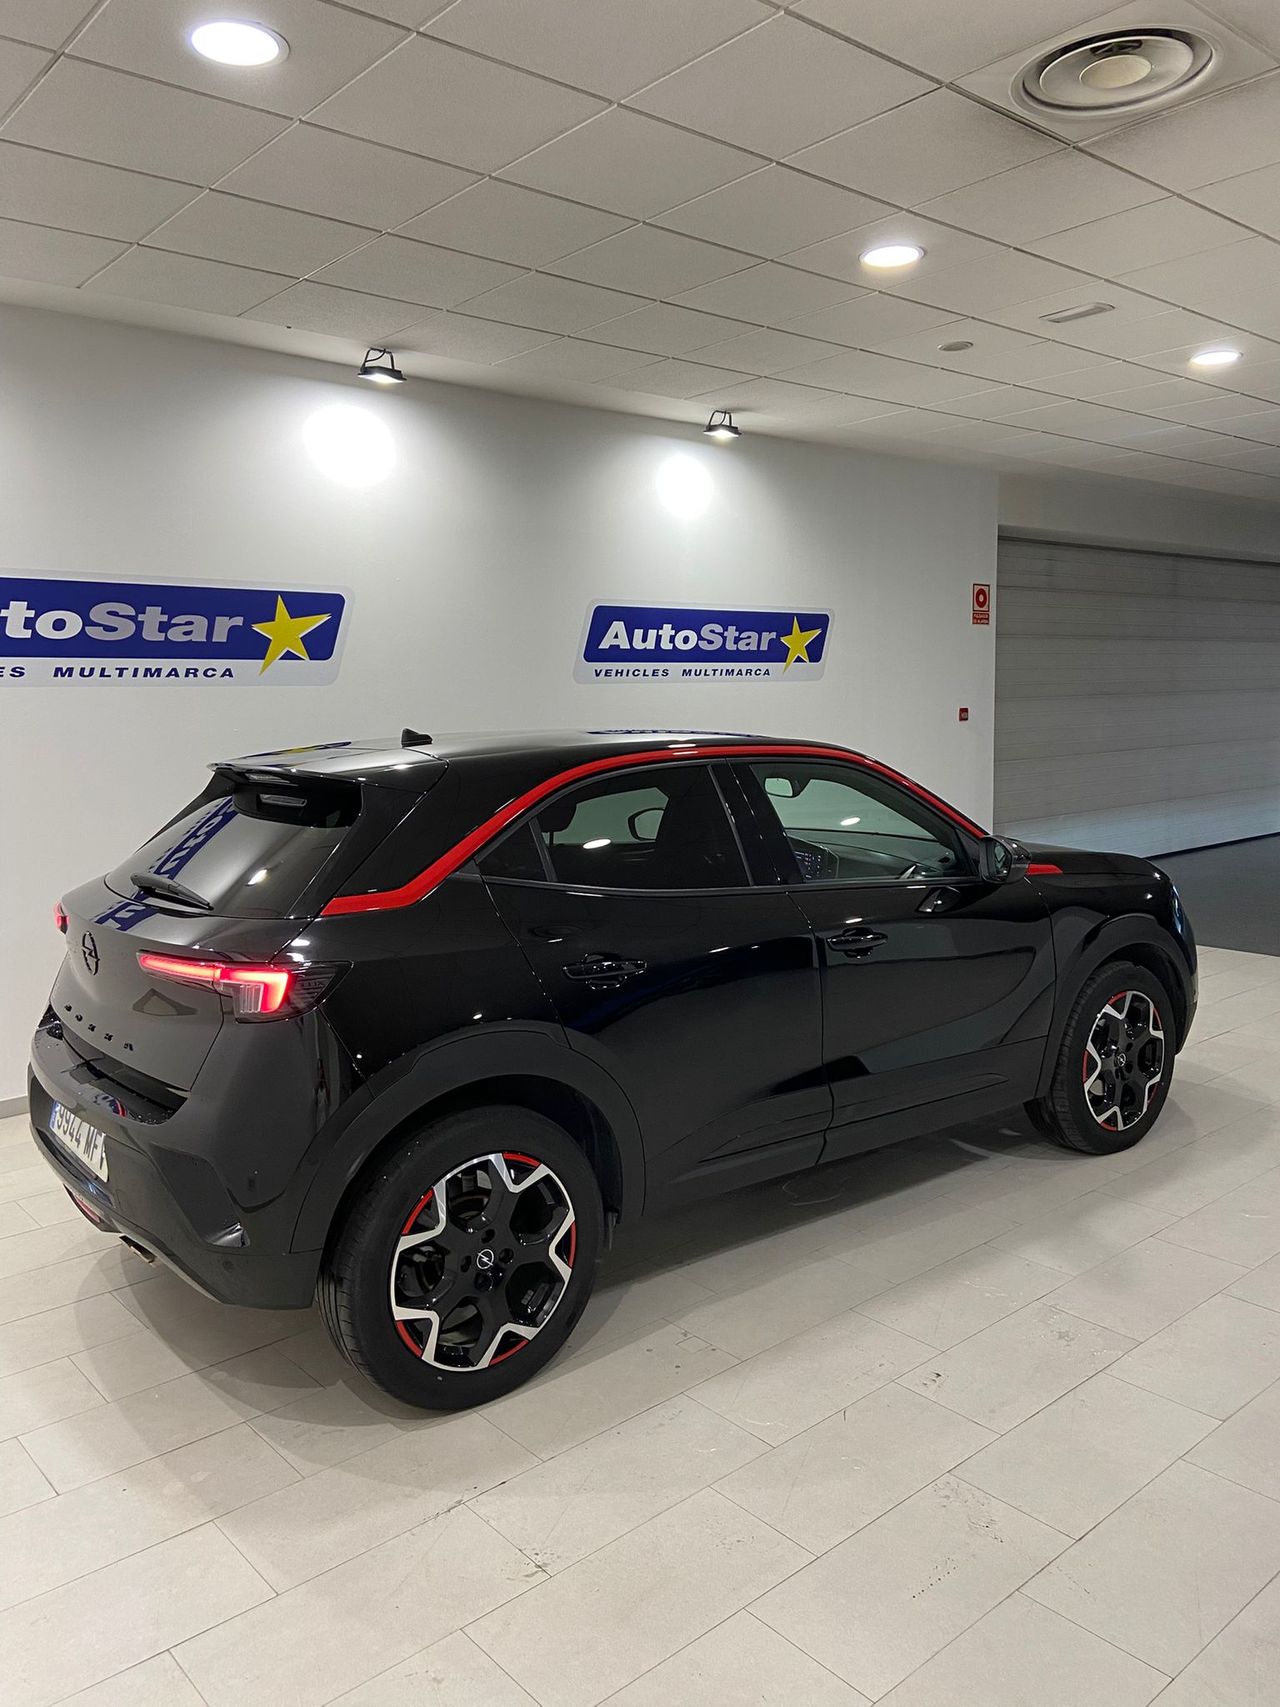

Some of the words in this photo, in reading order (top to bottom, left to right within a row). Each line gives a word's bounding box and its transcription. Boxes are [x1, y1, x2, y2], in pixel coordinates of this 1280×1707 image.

[599, 621, 776, 651] AutoStar
[54, 667, 234, 678] MULTIMARCA
[594, 668, 669, 678] VEHICLES
[682, 668, 771, 677] MULTIMARCA
